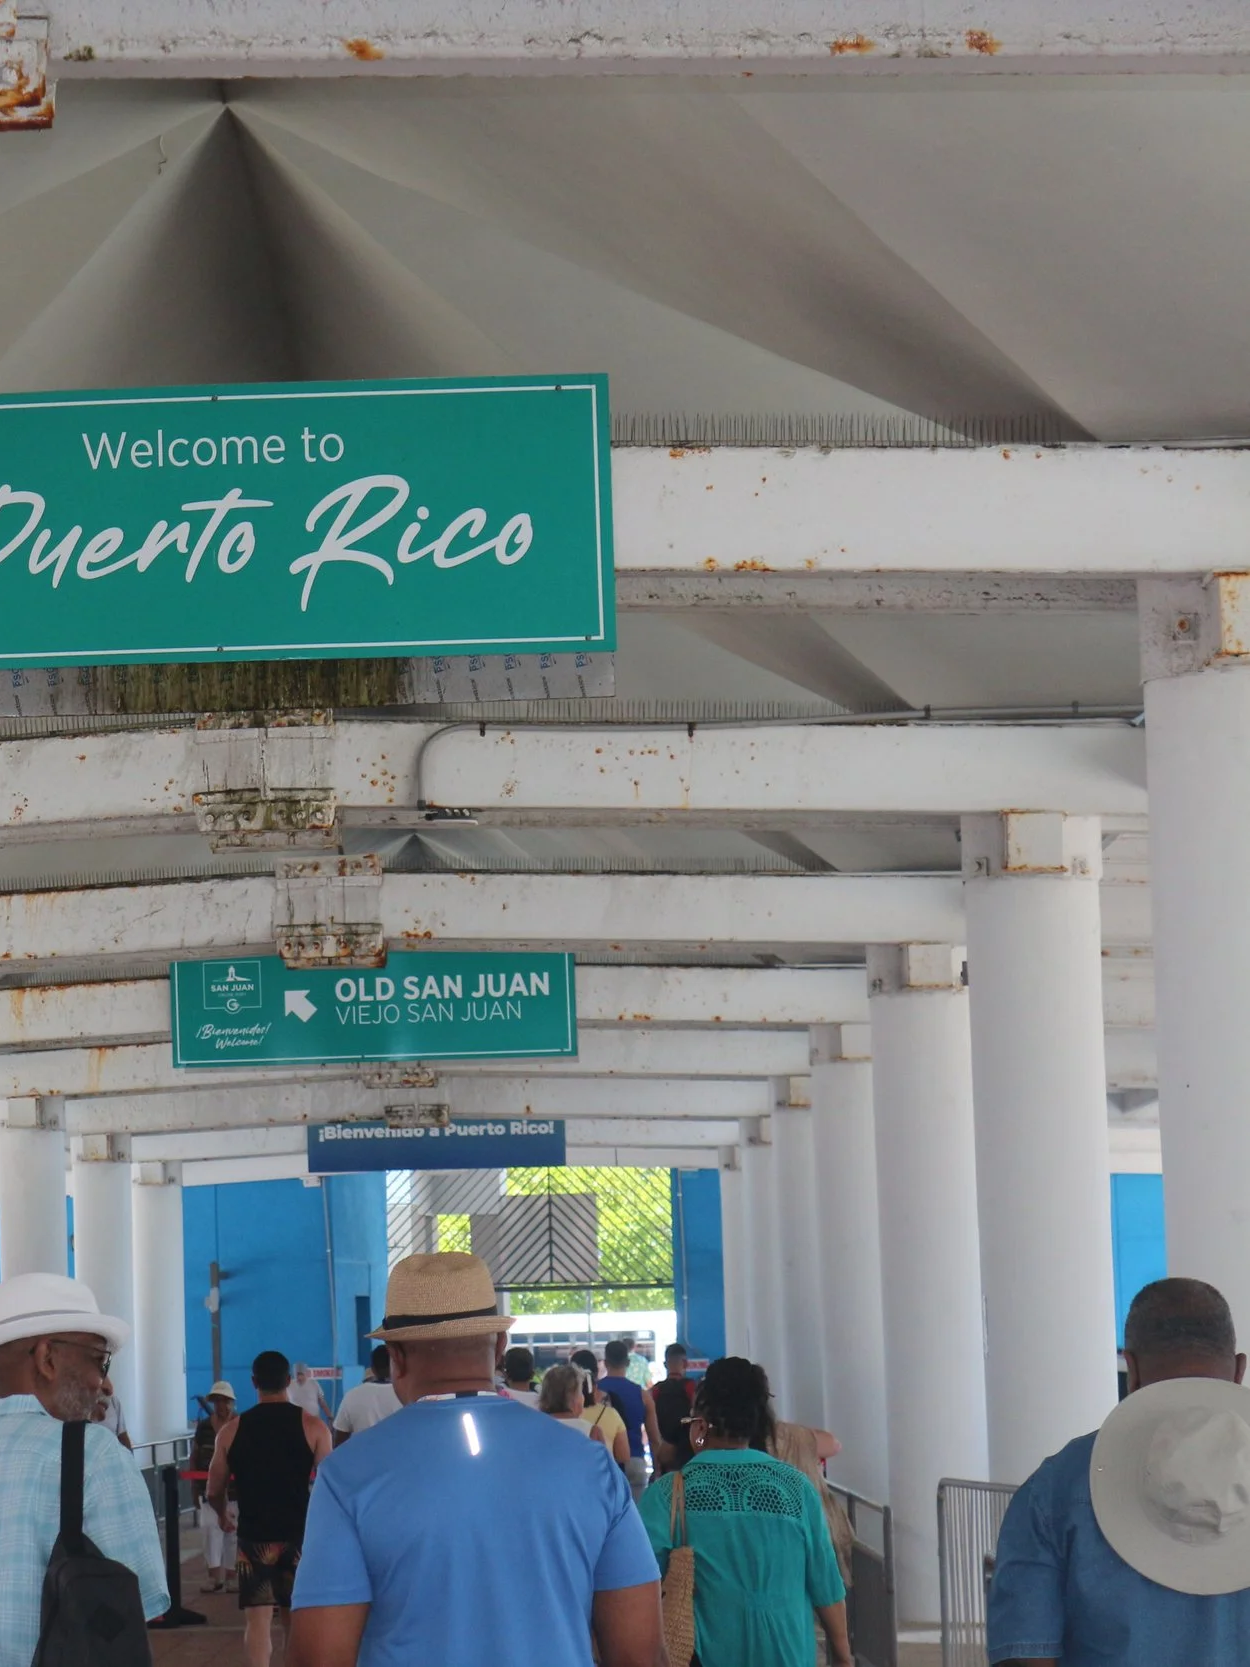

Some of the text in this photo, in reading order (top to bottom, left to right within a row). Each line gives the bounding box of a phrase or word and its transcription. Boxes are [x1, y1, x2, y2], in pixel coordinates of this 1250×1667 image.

[82, 426, 345, 470] Welcome to
[289, 474, 534, 612] Rico
[210, 983, 254, 993] SAN JUAN
[335, 971, 550, 1003] OLD SAN JUAN
[335, 1000, 522, 1025] VIEJO SAN JUAN
[215, 1036, 265, 1050] Welcome!
[444, 1121, 506, 1138] Puerto
[510, 1120, 555, 1136] Rico!
